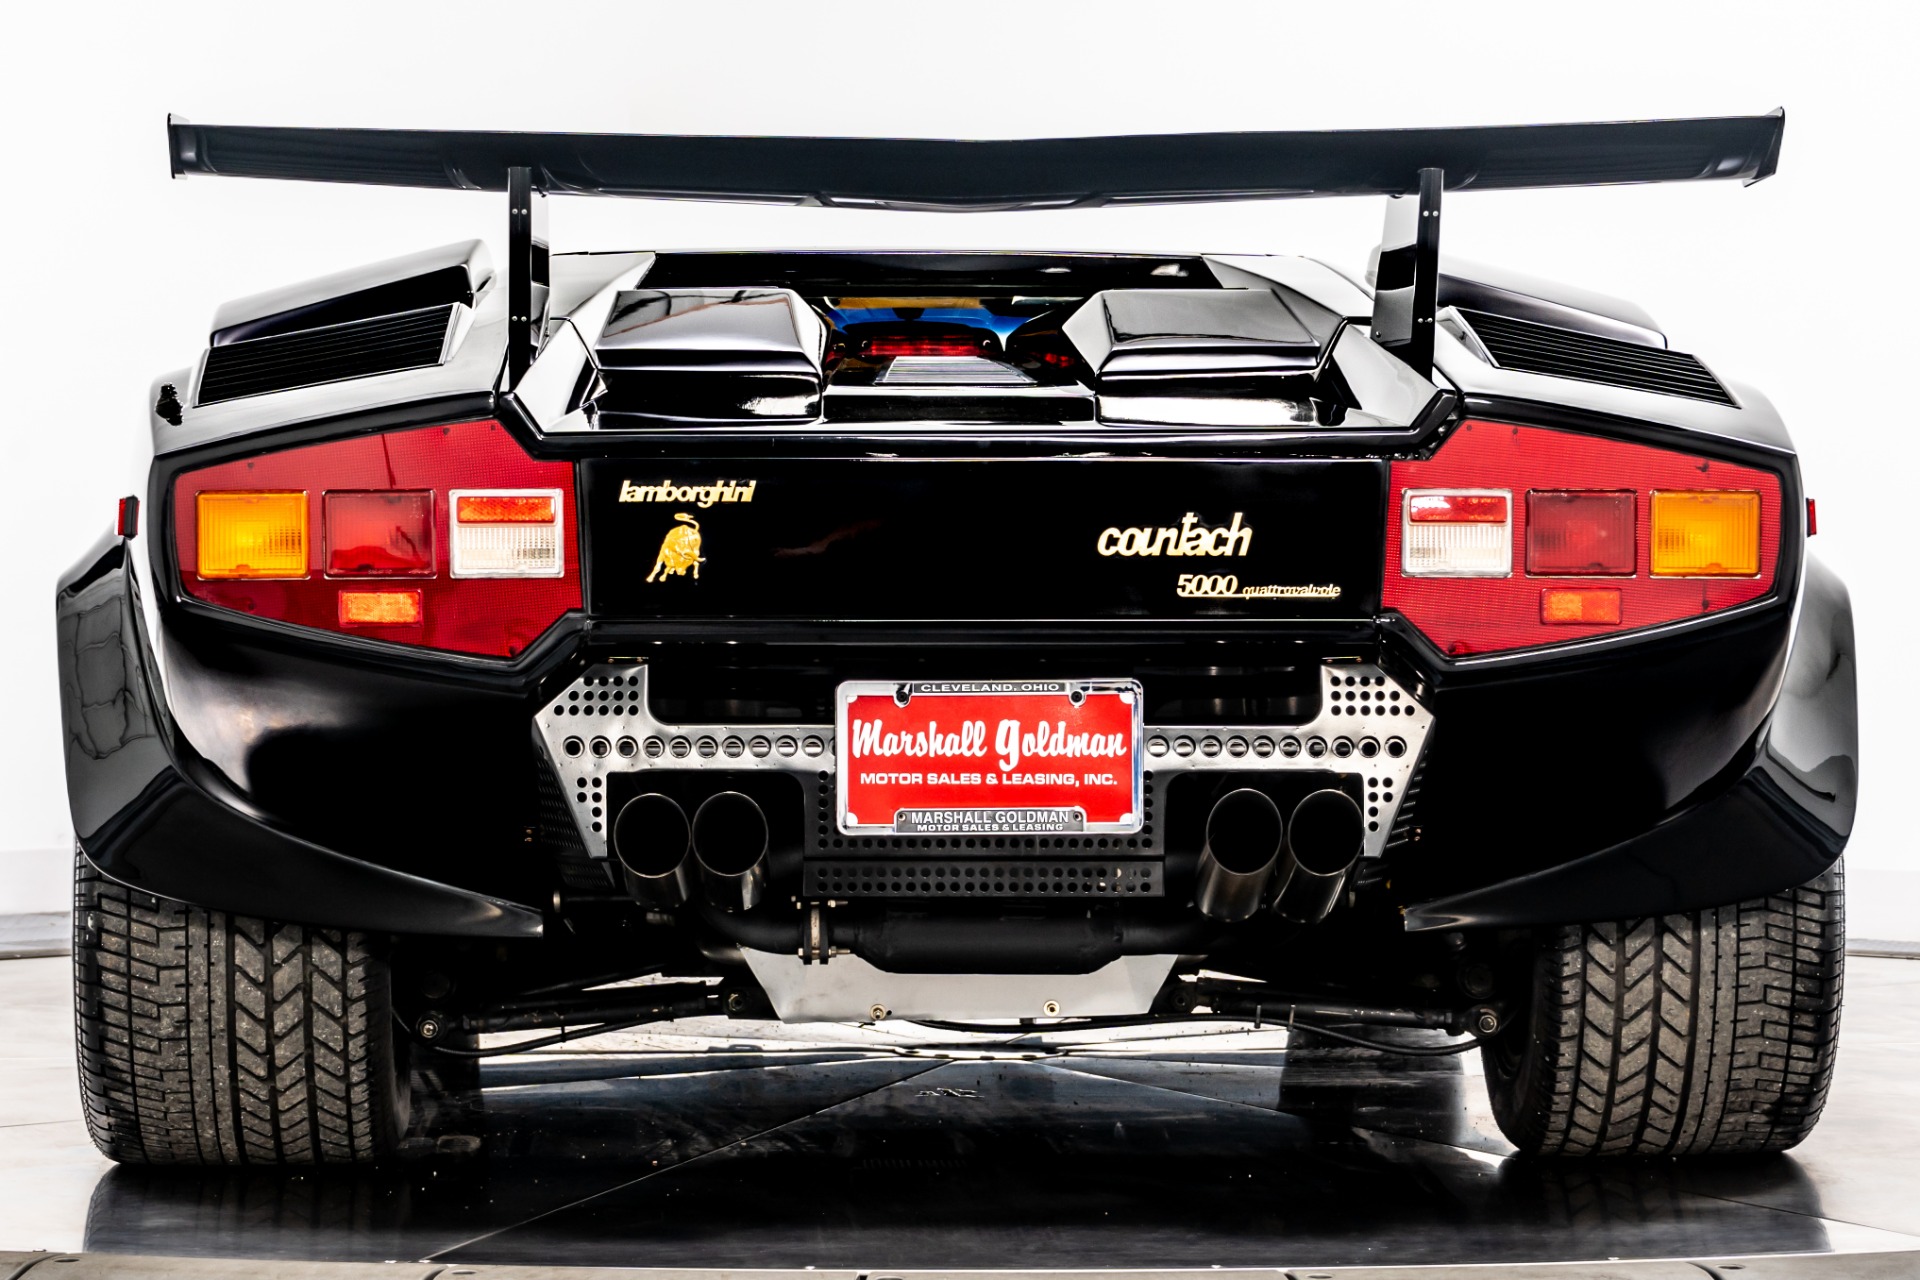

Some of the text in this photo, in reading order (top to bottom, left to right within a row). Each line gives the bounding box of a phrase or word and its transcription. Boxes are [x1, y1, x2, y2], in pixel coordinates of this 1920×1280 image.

[618, 479, 757, 509] lamborghini
[1097, 512, 1253, 557] countach
[1176, 574, 1342, 600] 5000 quattrovalvole
[1021, 683, 1060, 691] OHIO
[852, 719, 987, 758] Marshall
[860, 773, 1118, 787] MOTOR SALES & LEASING, INC.
[911, 811, 1069, 824] MARSHALL GOLDMAN
[917, 824, 958, 832] MOTOR
[1012, 823, 1064, 831] LEASING
